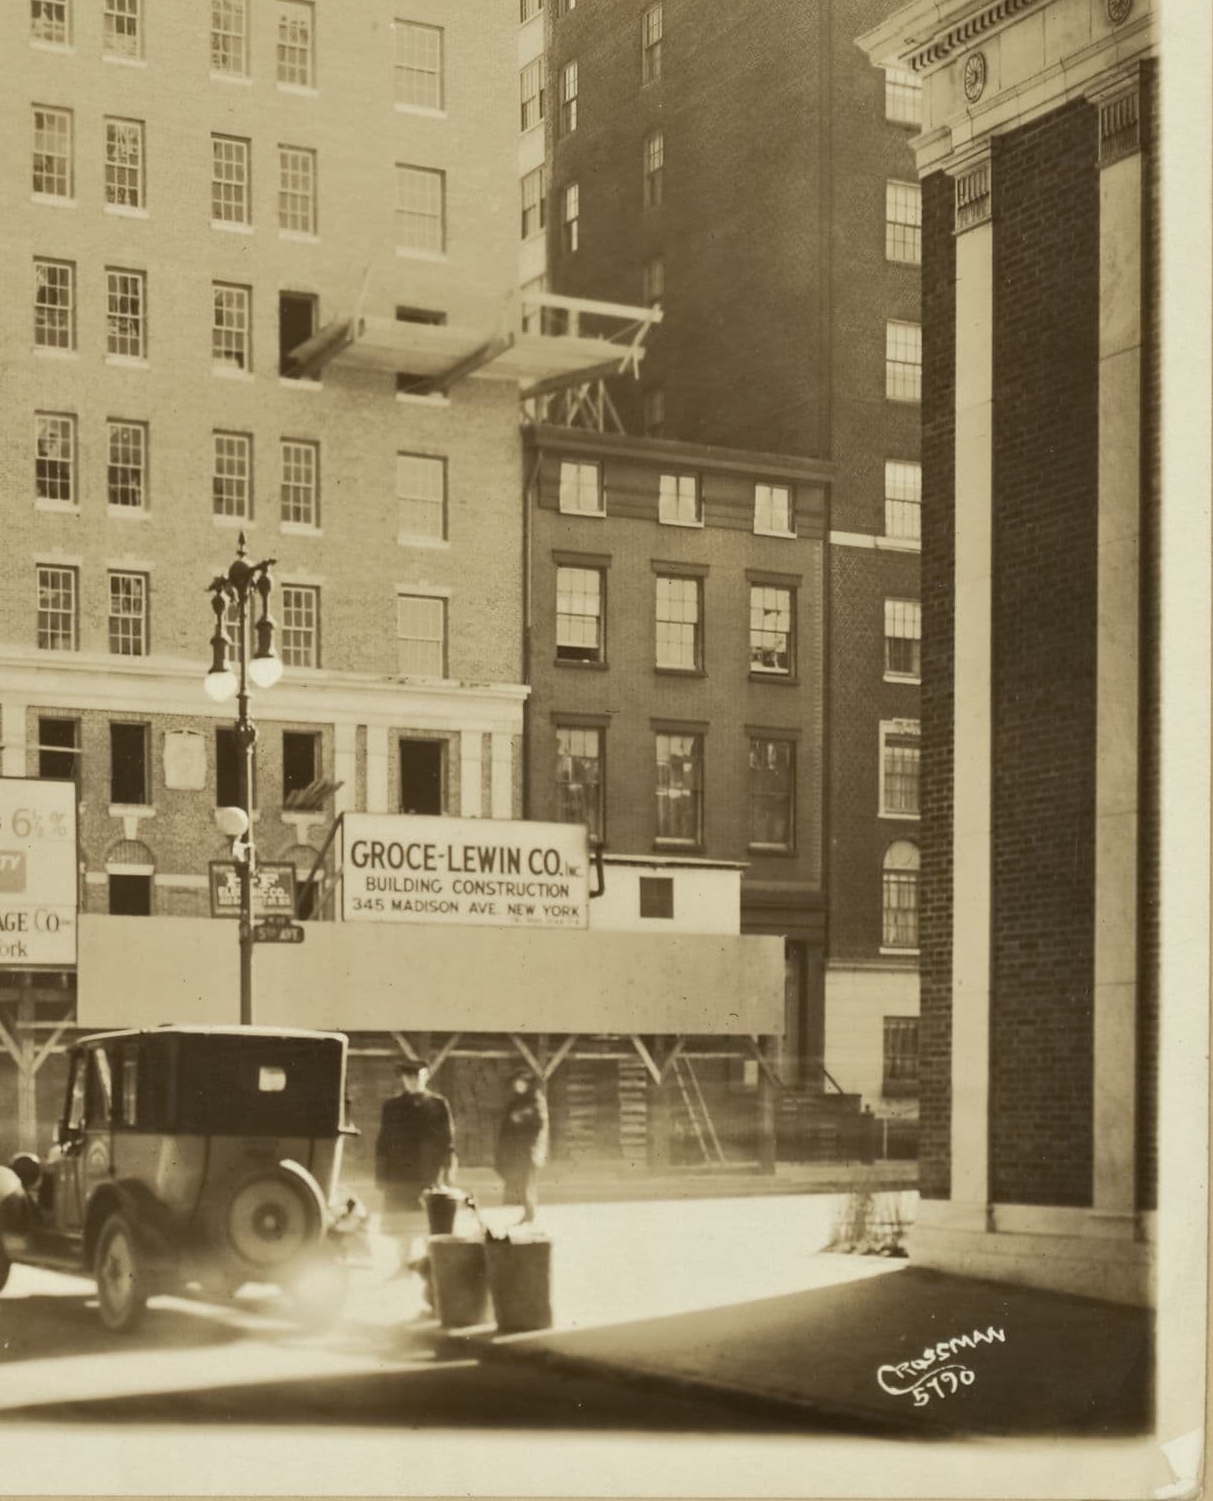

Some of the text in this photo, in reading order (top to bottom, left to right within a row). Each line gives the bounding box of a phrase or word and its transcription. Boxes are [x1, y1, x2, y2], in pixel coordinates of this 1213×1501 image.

[350, 840, 521, 875] GROCE-LEWIN
[528, 848, 563, 876] CO.
[365, 876, 570, 898] BUILDING CONSTRUCTION
[352, 897, 386, 911] 345
[390, 898, 460, 914] MADISON
[507, 903, 536, 917] NEW
[543, 904, 581, 918] YORK
